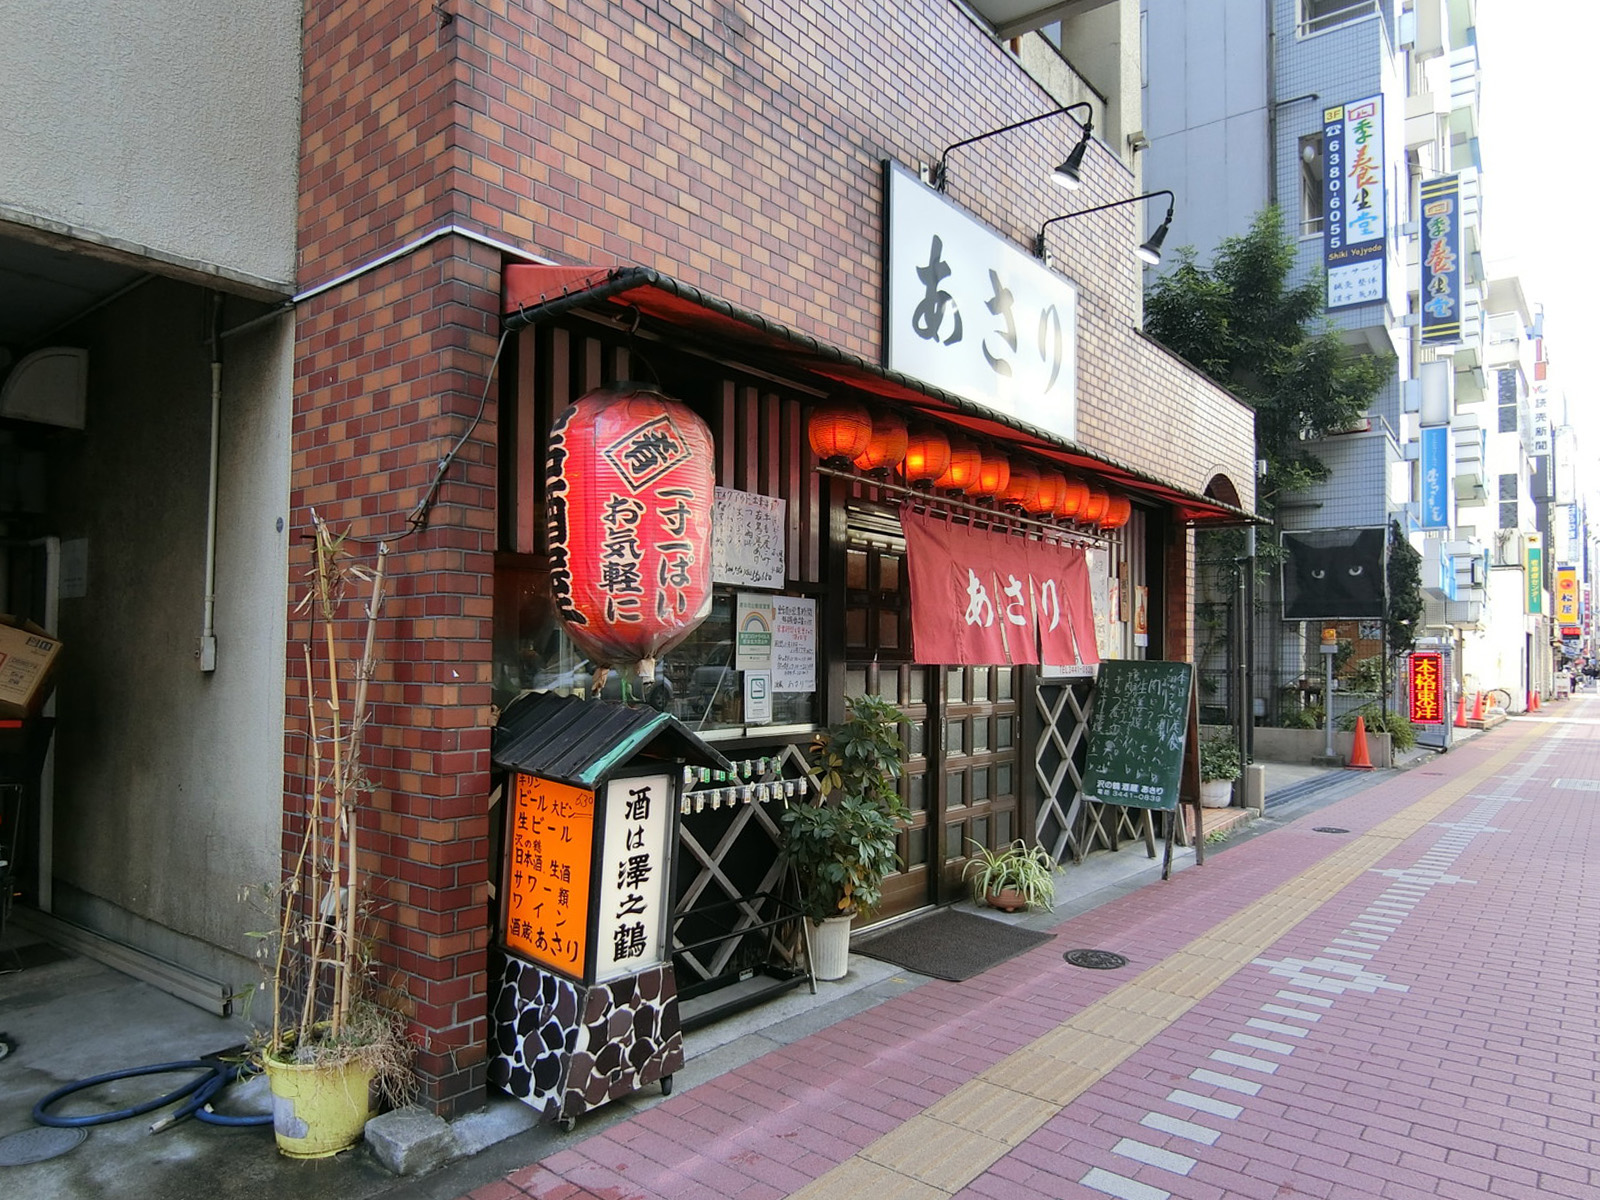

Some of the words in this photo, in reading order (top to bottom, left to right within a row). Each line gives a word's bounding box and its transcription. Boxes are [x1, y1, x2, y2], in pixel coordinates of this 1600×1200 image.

[1326, 110, 1341, 121] 3F
[1347, 102, 1380, 235] 四季養生堂
[1329, 140, 1341, 249] 6380-6055
[1328, 251, 1348, 261] Shiki
[1425, 200, 1455, 317] 四季養生堂
[911, 234, 1063, 395] あさり
[1534, 398, 1548, 451] 読売新聞
[599, 494, 645, 624] お気軽に
[964, 567, 1060, 633] あさり
[1561, 592, 1573, 614] 松屋
[519, 788, 548, 812] ビール
[551, 800, 575, 819] 大ビン
[575, 793, 593, 809] 630
[1112, 790, 1162, 803] 3441-0839
[1140, 785, 1164, 796] あさり
[518, 811, 573, 843] 生ビール
[612, 785, 653, 963] 酒は澤之鶴
[513, 893, 567, 928] ワイン
